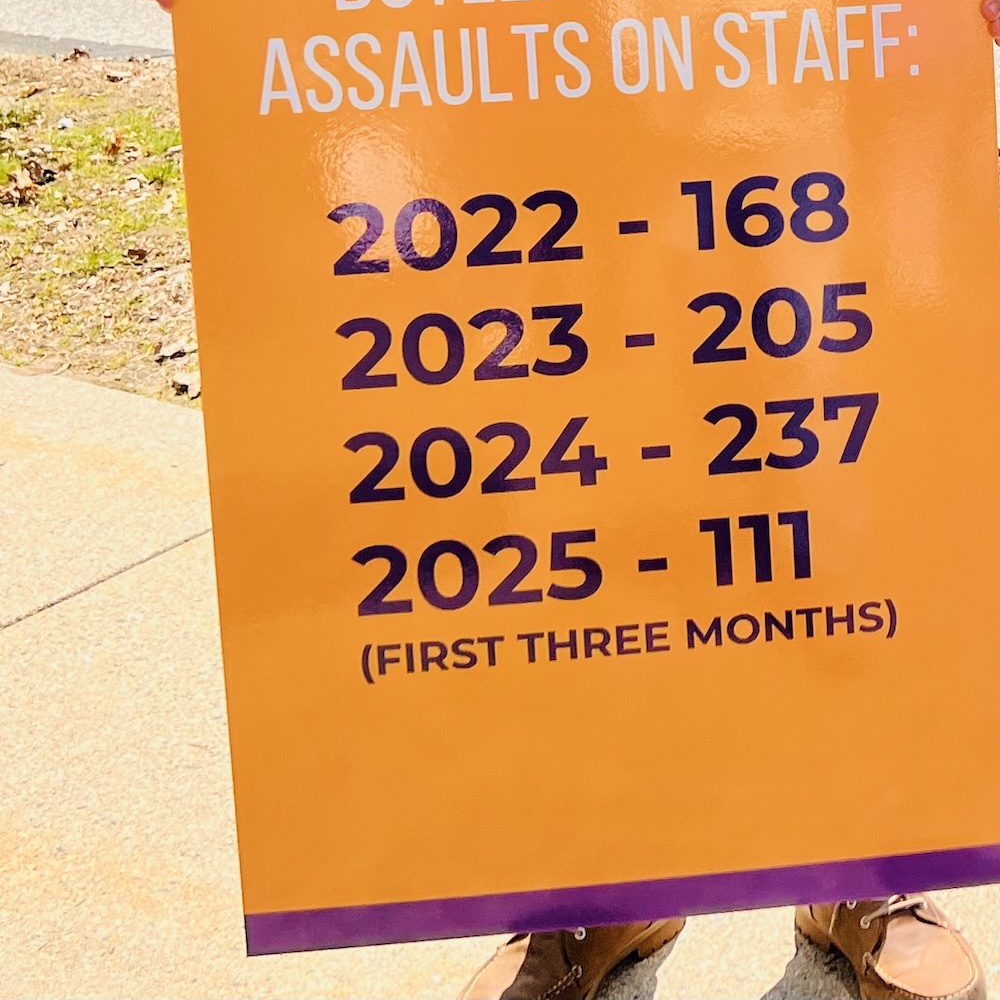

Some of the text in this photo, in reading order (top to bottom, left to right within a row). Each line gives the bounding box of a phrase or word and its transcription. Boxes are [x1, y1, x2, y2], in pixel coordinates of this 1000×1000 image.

[259, 3, 921, 115] ASSAULTS ON STAFF:
[326, 172, 849, 276] 2022 - 168
[334, 281, 873, 391] 2023 - 205
[342, 392, 880, 504] 2024 - 237
[351, 509, 812, 617] 2025 - 111
[361, 598, 898, 684] (FIRST THREE MONTHS)
